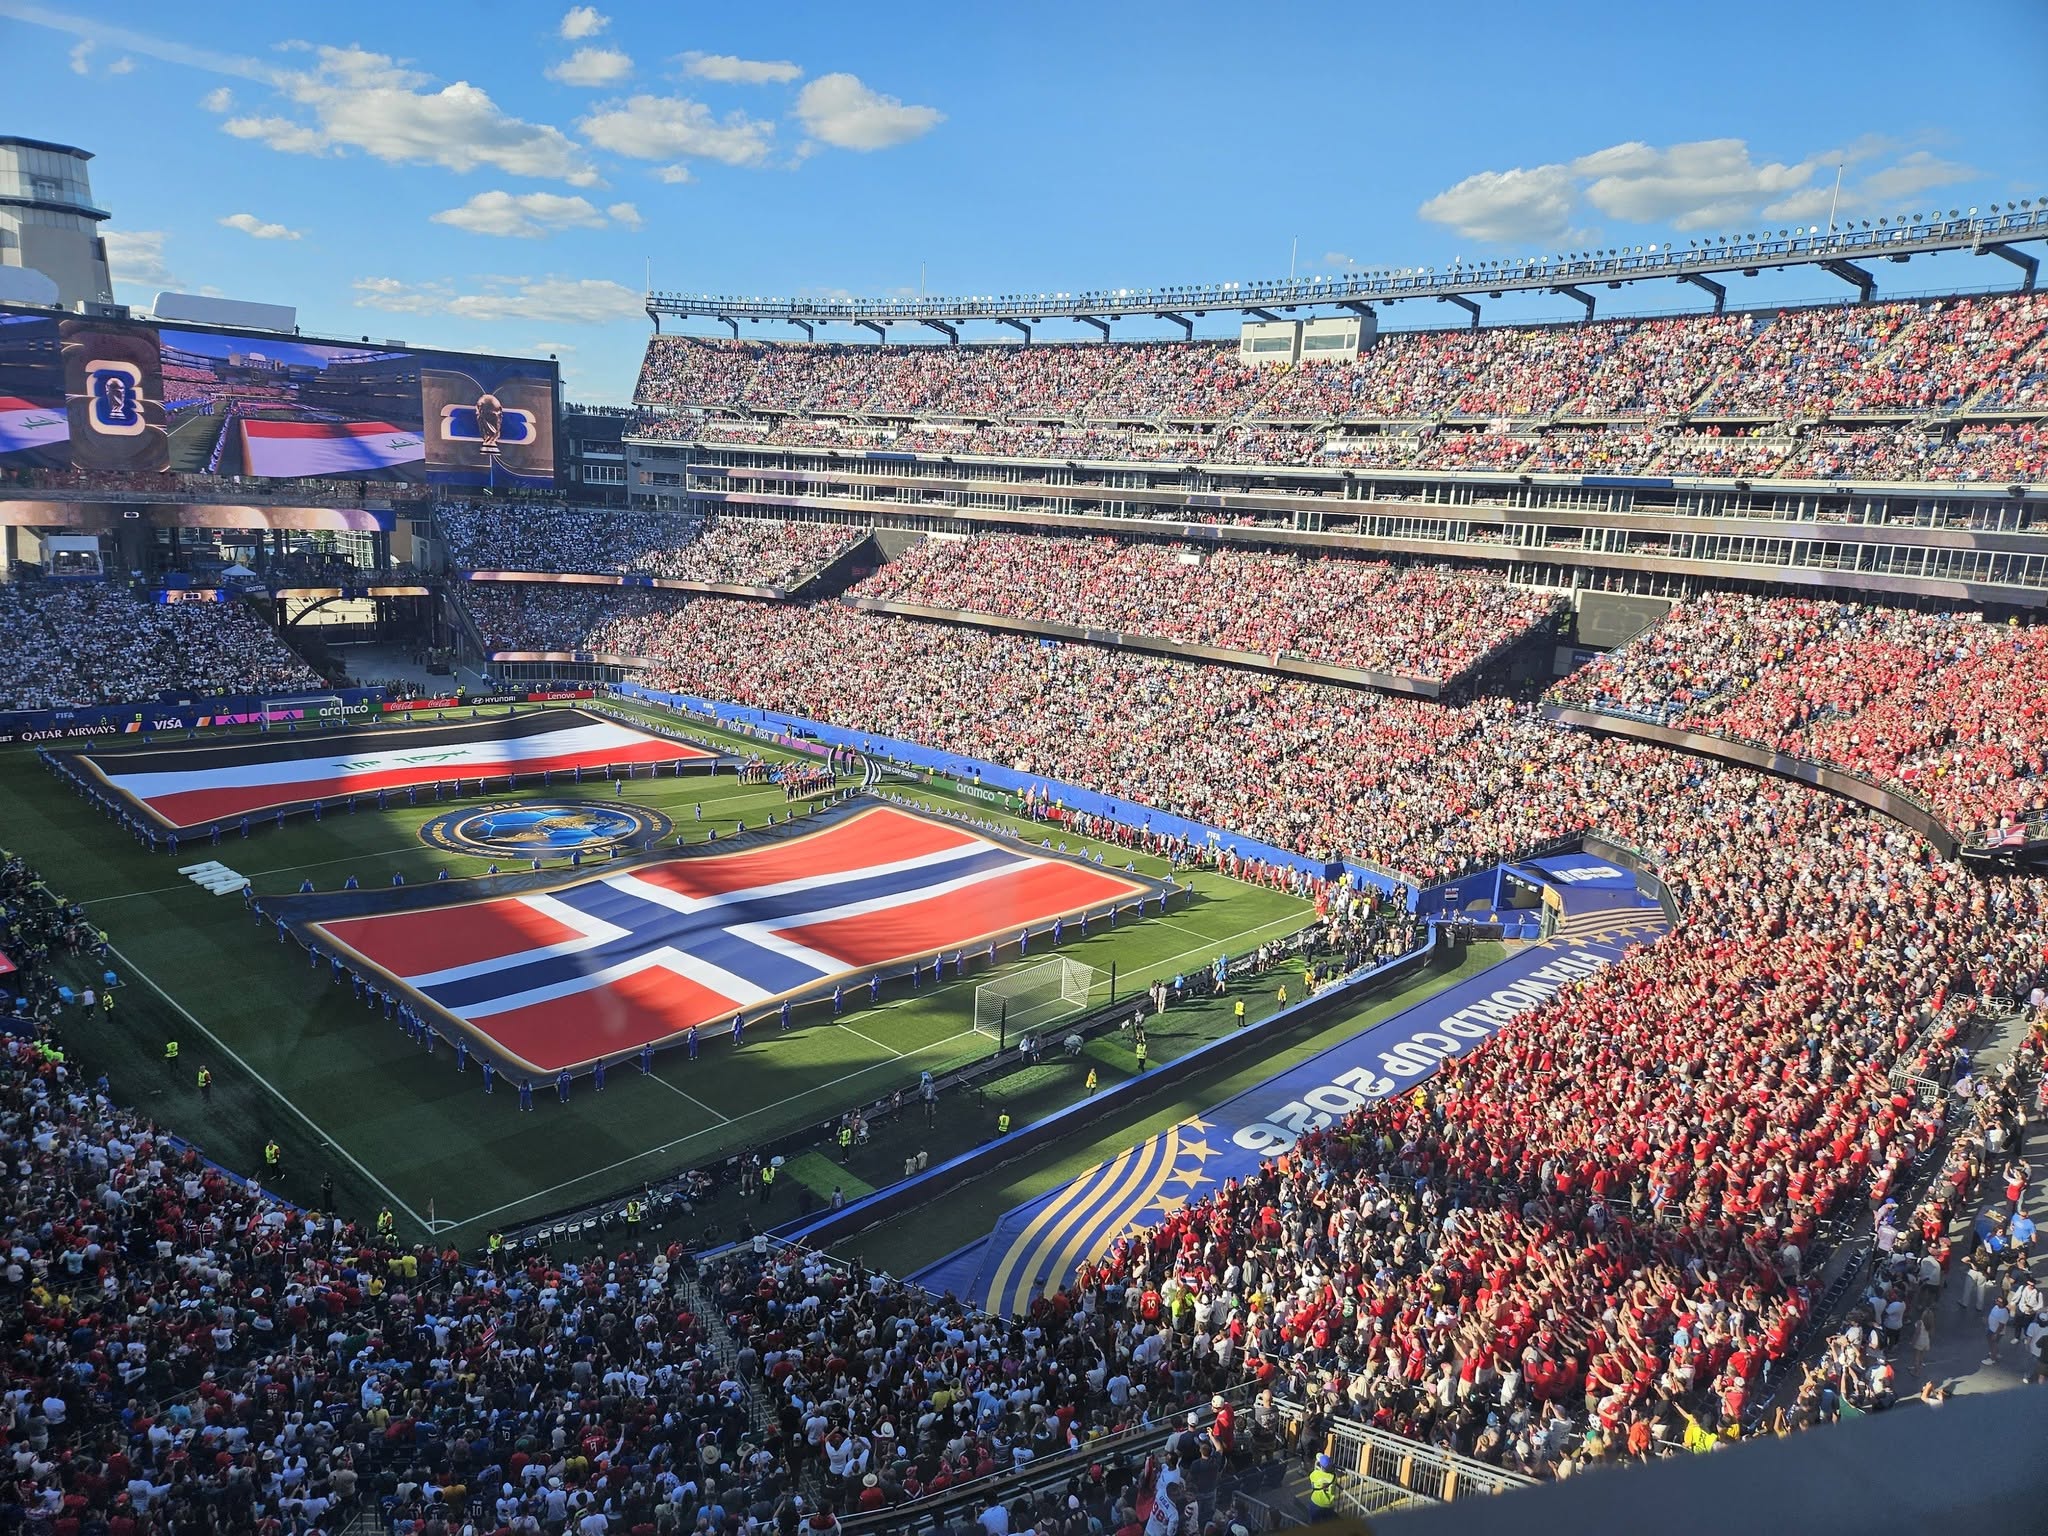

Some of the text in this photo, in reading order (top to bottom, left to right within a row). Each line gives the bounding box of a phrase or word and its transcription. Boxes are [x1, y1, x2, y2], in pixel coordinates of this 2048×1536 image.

[245, 585, 266, 593] BOSTON
[484, 695, 516, 703] HYUNDAI
[547, 691, 576, 700] Lenovo
[607, 692, 620, 701] ADI
[319, 704, 369, 717] aramco
[703, 702, 714, 710] FIFA
[55, 711, 75, 720] FIFA
[152, 718, 183, 730] VISA
[727, 720, 742, 733] VISA
[21, 724, 117, 742] QATAR AIRWAYS
[754, 728, 769, 741] VISA
[956, 782, 995, 802] aramco
[1206, 830, 1221, 841] FIFA
[1232, 950, 1612, 1157] FIFA WORLD CUP 2026
[1159, 1495, 1170, 1510] USA
